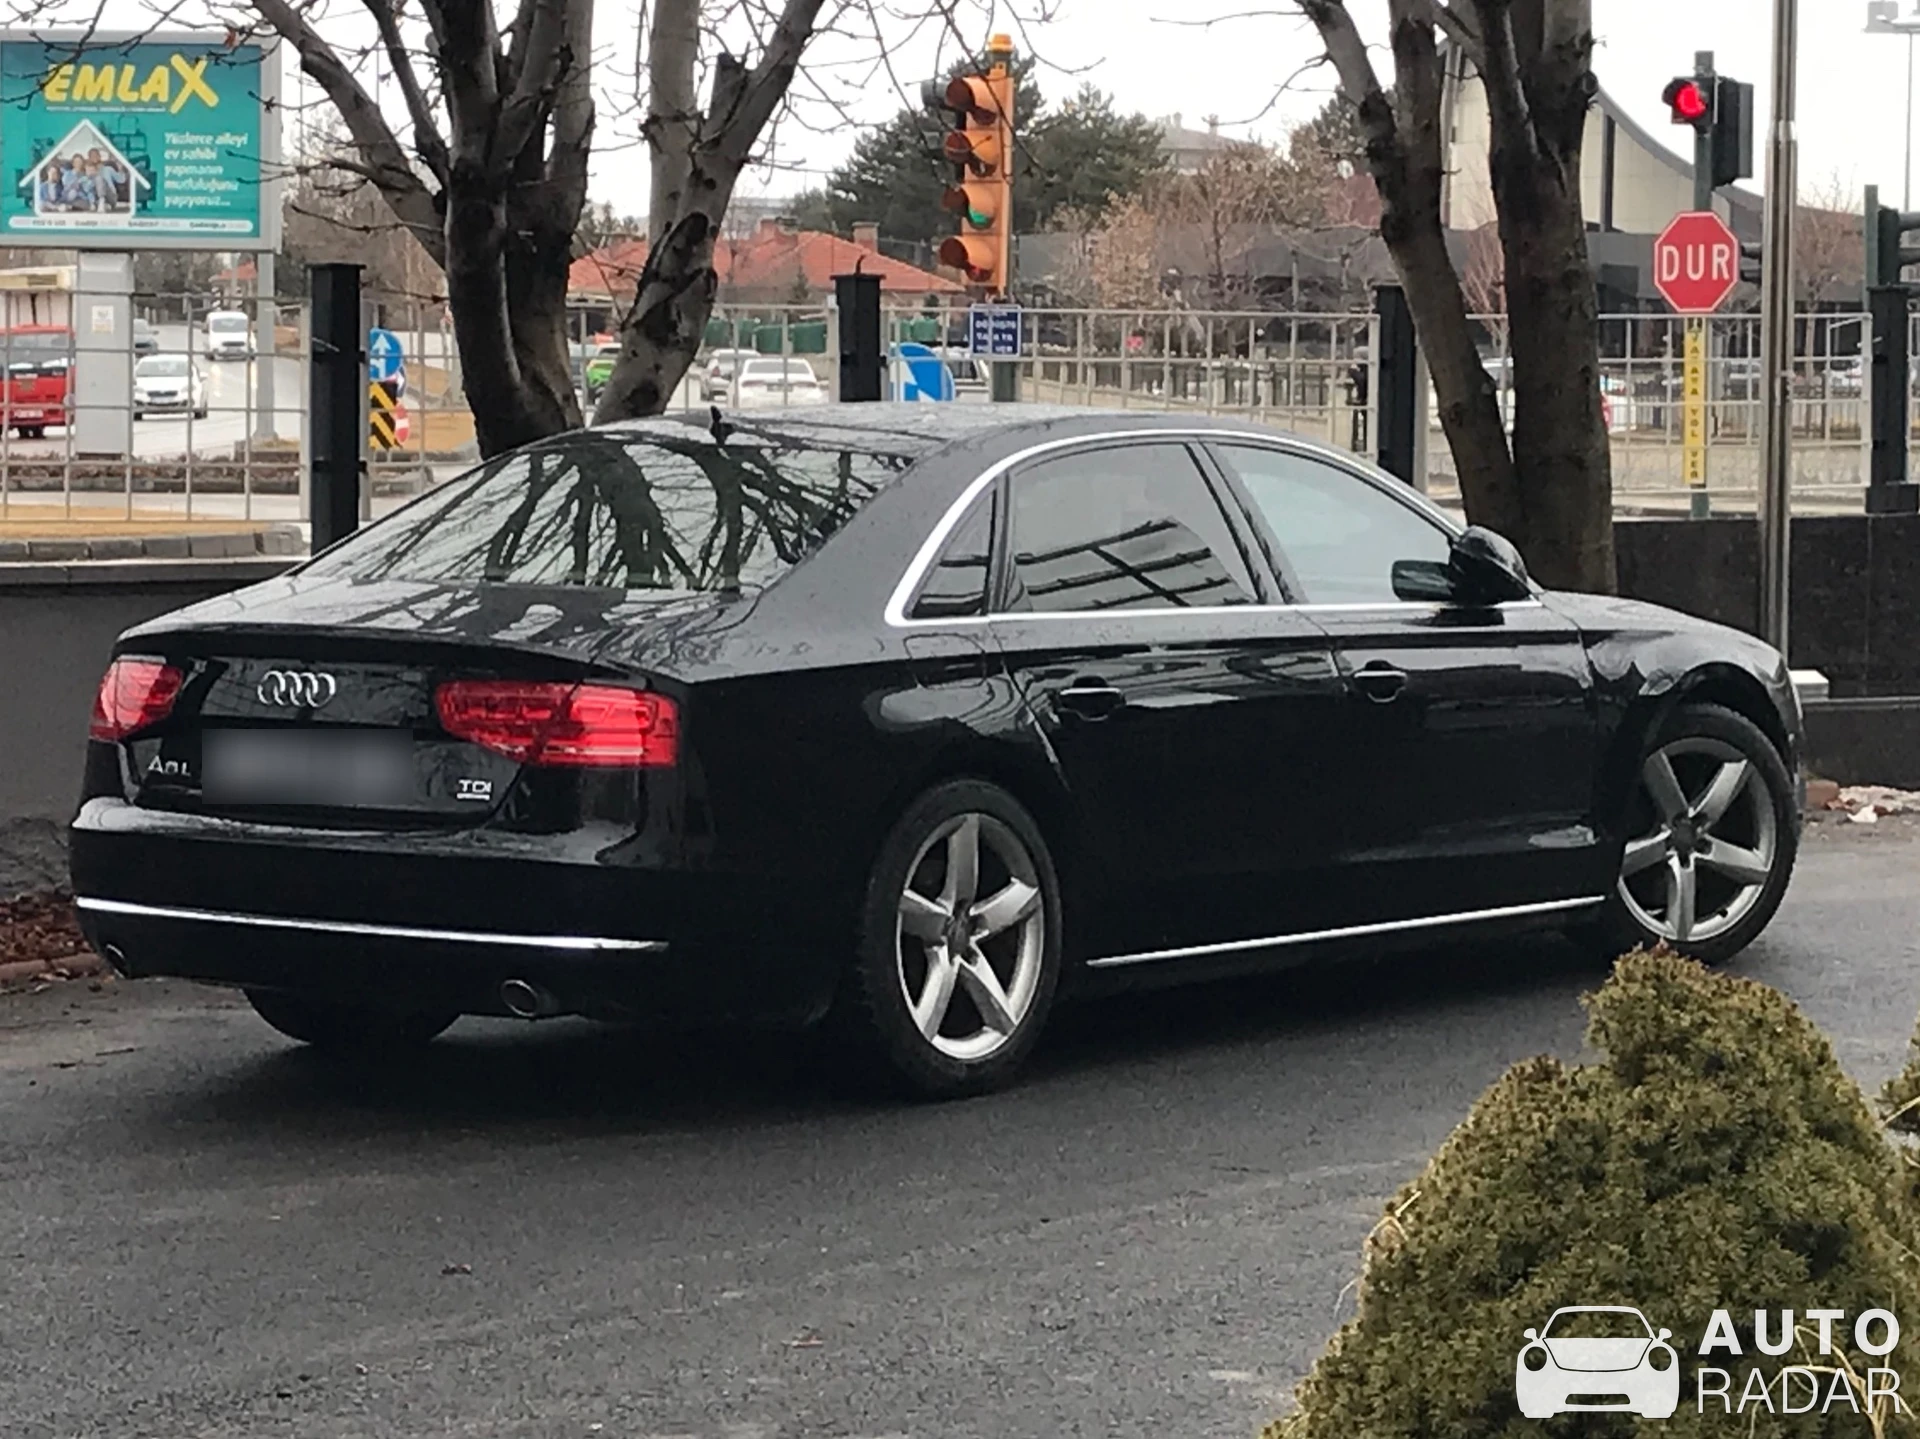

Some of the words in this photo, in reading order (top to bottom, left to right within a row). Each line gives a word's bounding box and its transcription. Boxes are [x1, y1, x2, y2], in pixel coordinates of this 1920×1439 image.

[44, 53, 219, 114] EMLAX
[164, 150, 180, 160] ev
[1661, 243, 1731, 281] DUR
[459, 779, 492, 792] TDI
